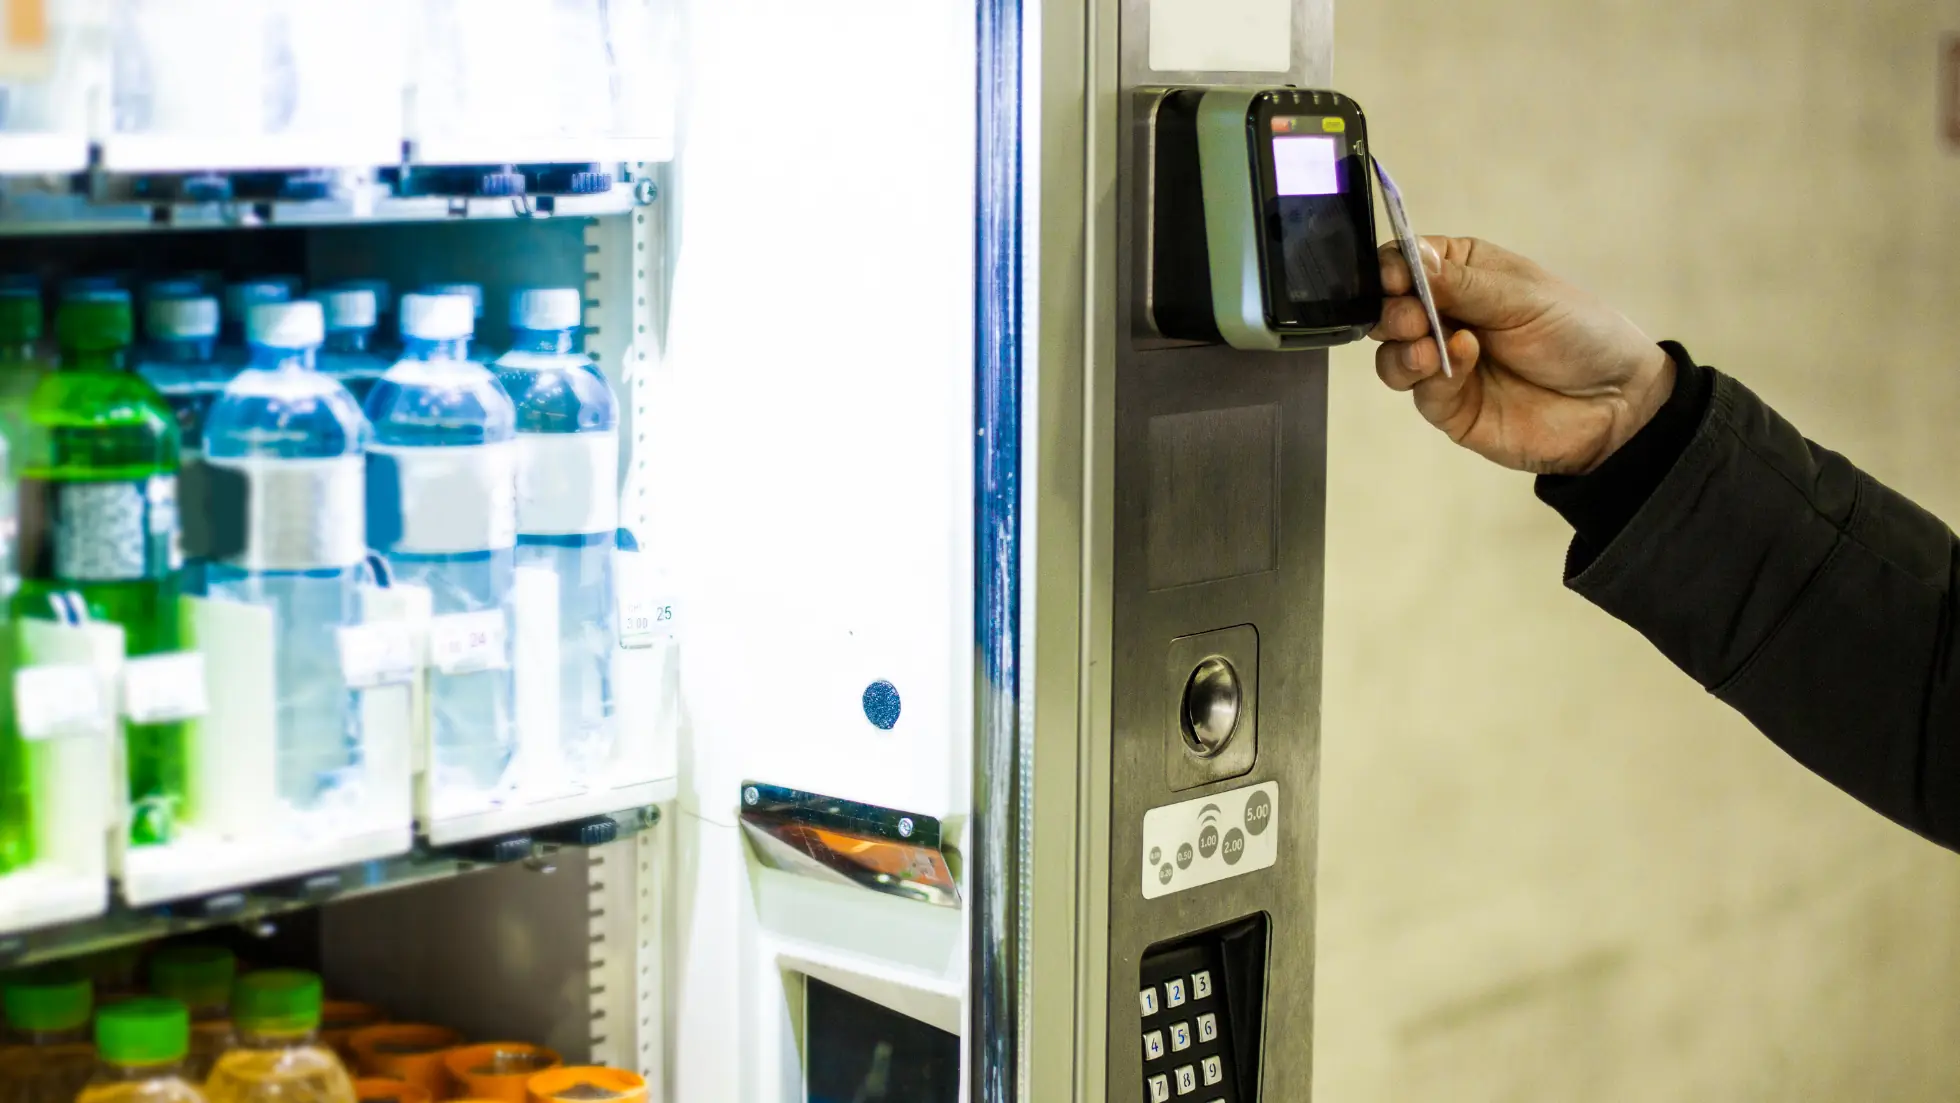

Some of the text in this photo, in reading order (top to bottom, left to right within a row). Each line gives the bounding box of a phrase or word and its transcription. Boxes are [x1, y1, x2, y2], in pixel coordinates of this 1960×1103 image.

[656, 605, 672, 622] 25
[1247, 804, 1268, 821] 5.00
[1200, 835, 1216, 848] 1.00
[1224, 838, 1242, 853] 2.00
[1177, 850, 1192, 862] 0.50
[1146, 976, 1206, 1009] 1 2 3
[1151, 1020, 1212, 1052] 4 5 6
[1156, 1063, 1216, 1096] 7 8 9
